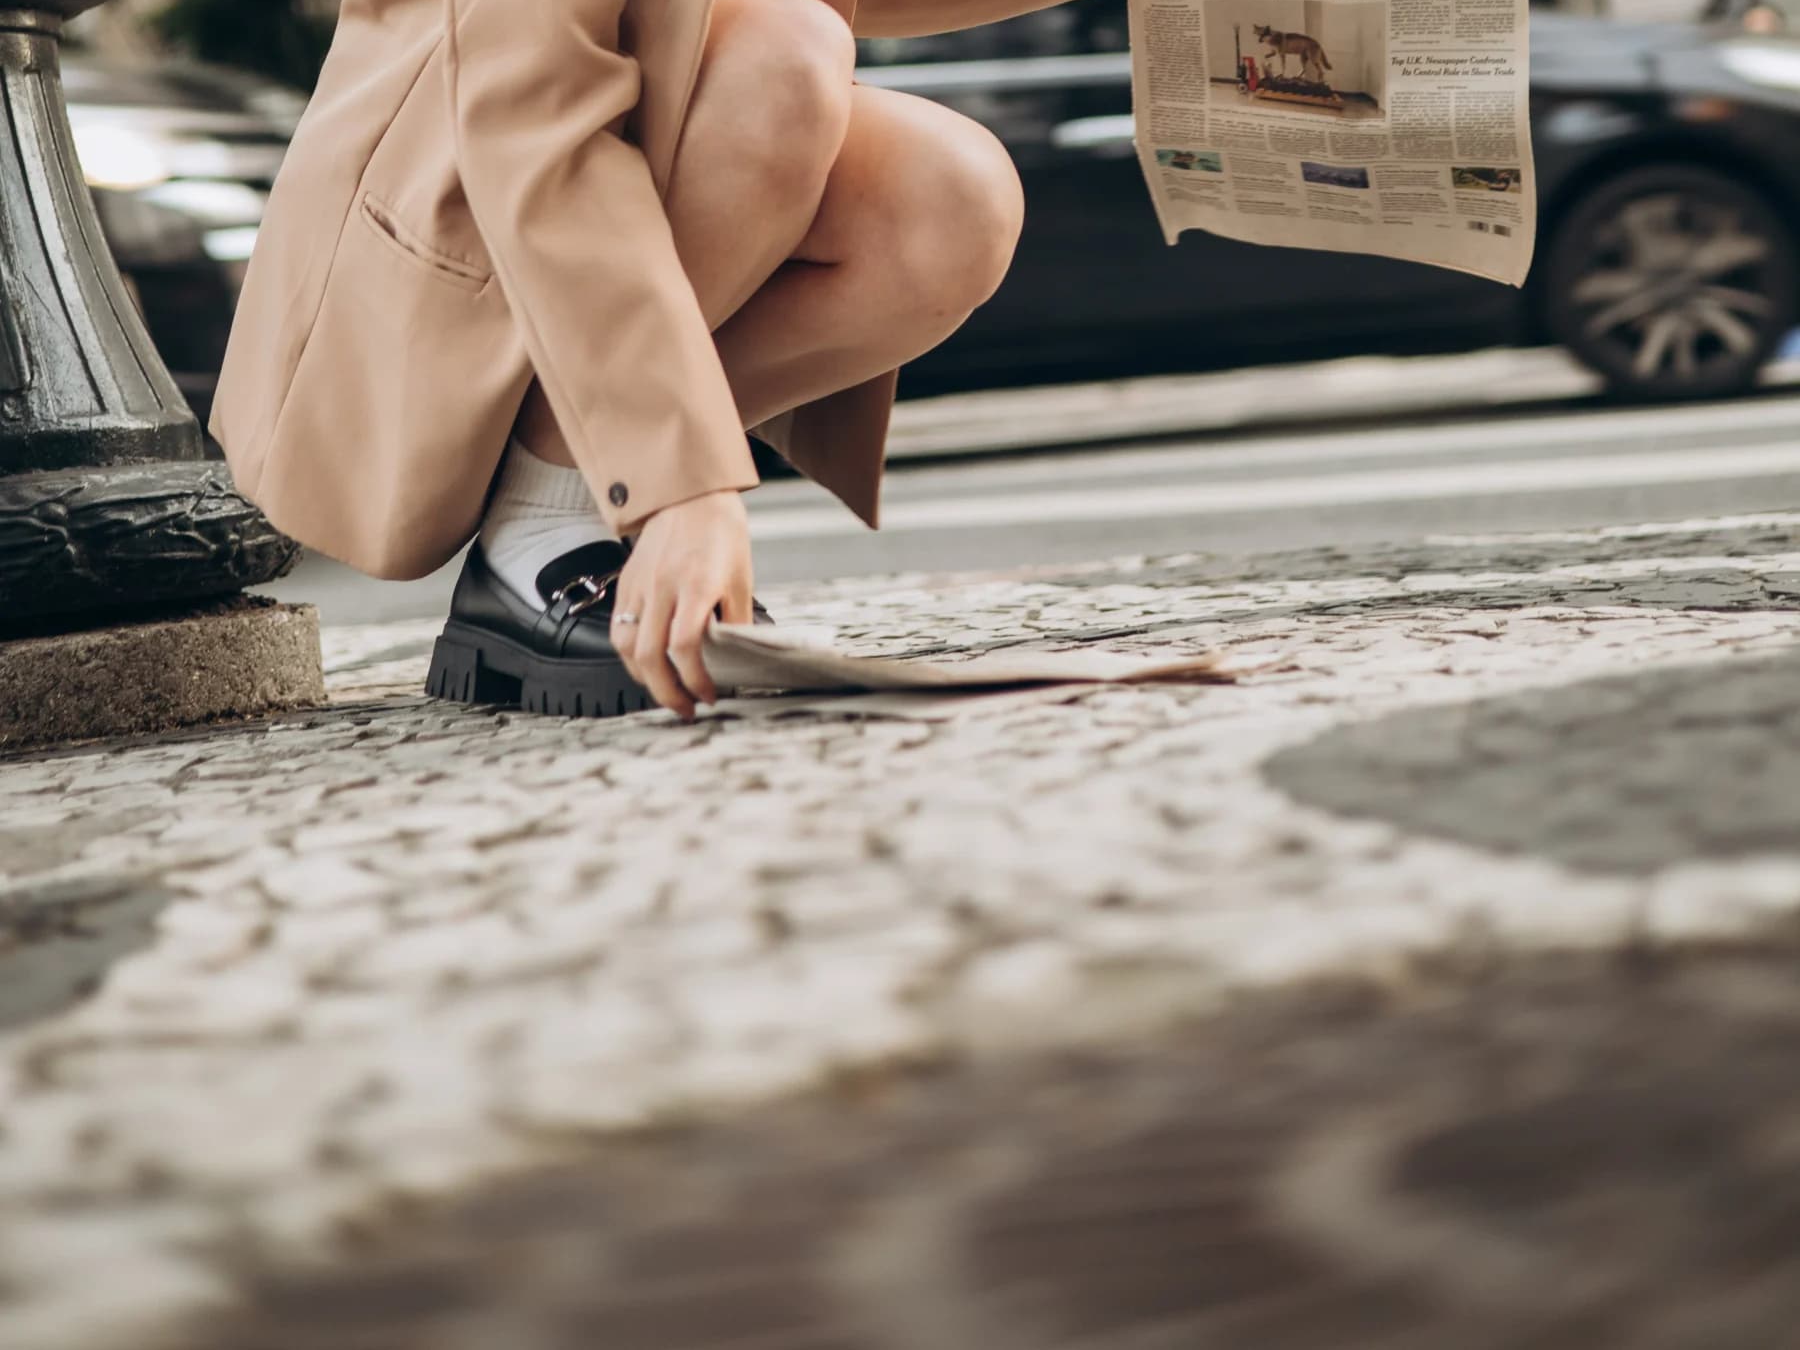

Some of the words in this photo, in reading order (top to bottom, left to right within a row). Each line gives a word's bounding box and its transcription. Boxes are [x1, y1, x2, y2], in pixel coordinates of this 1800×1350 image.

[1391, 56, 1405, 66] Top
[1425, 56, 1468, 66] Newspaper
[1401, 67, 1412, 76] Its
[1412, 67, 1442, 76] Central
